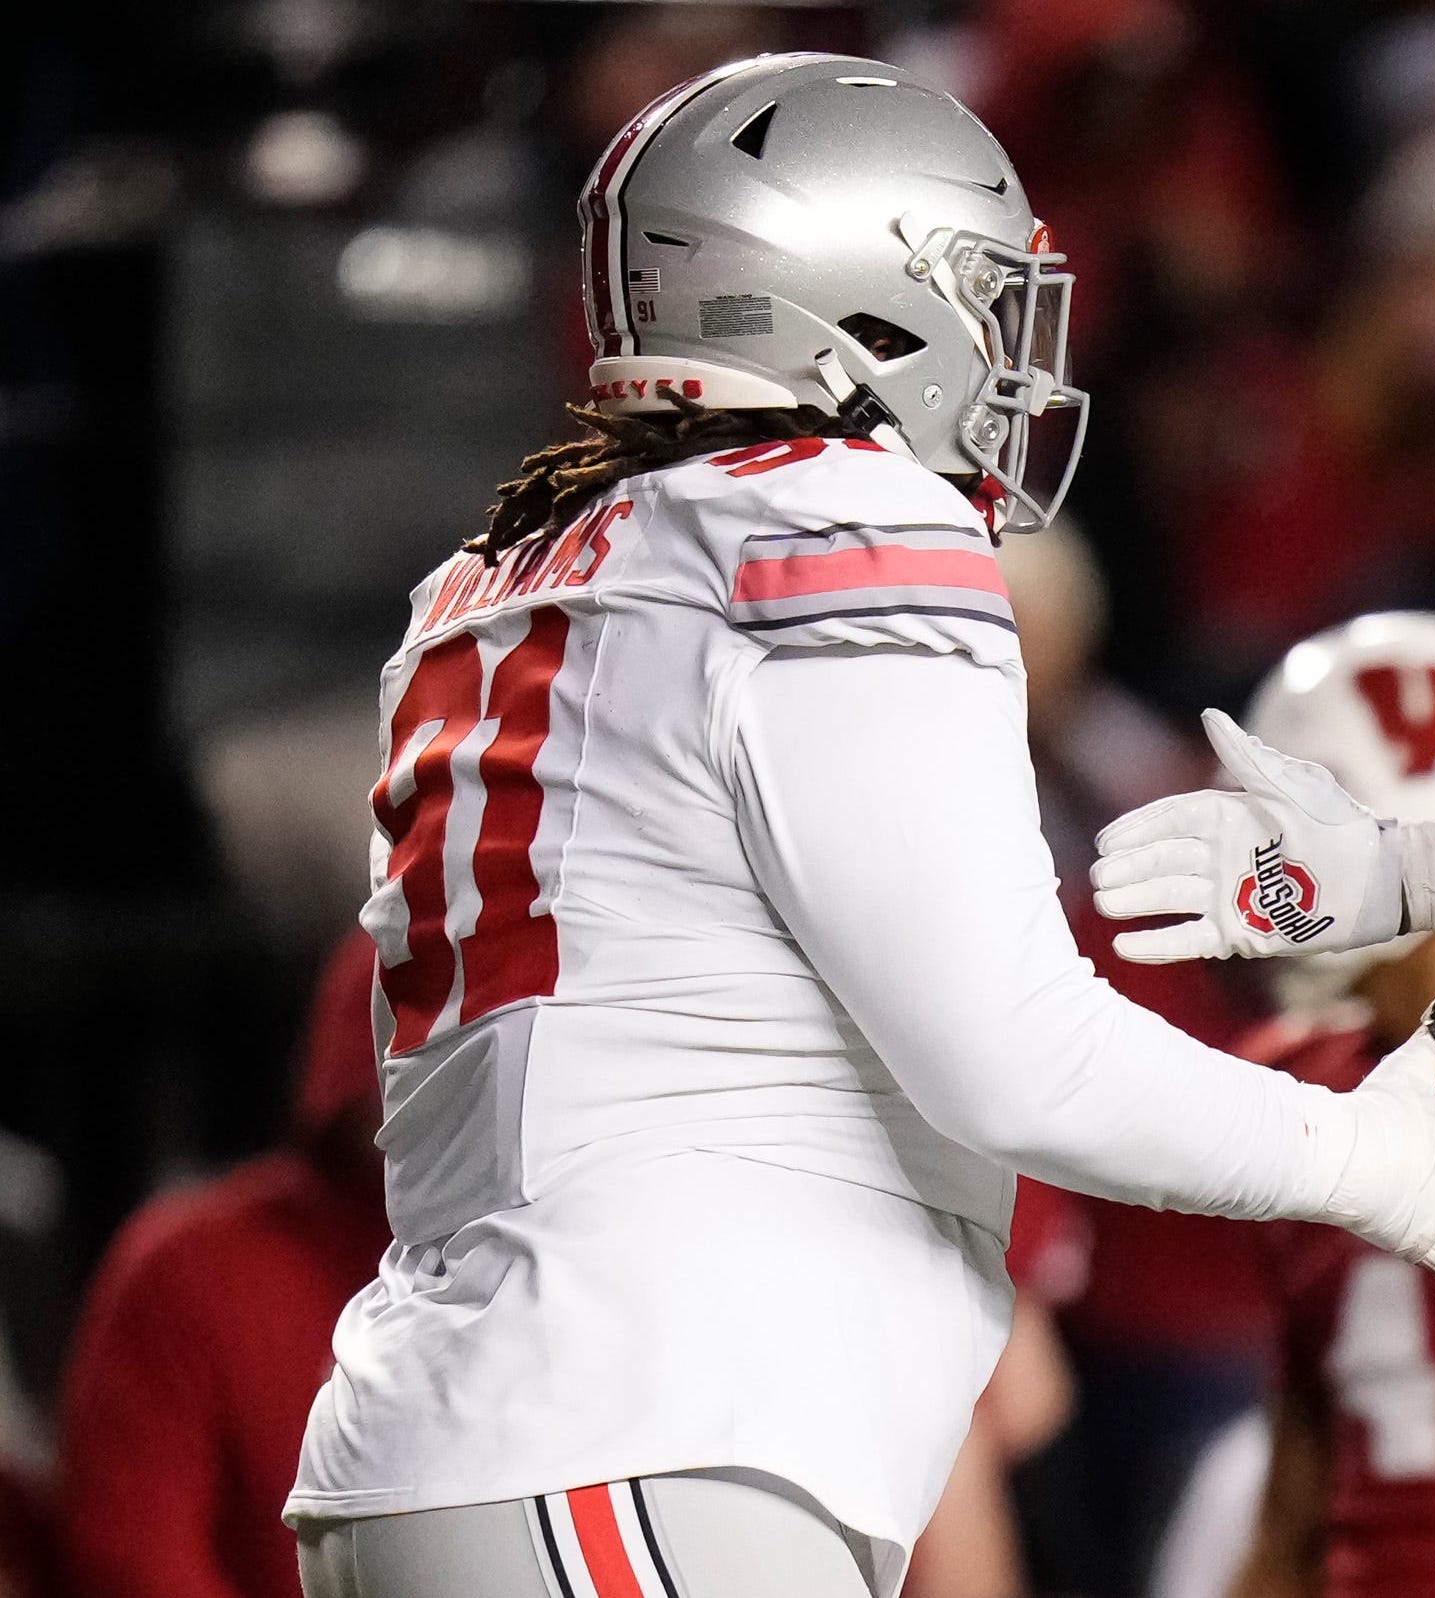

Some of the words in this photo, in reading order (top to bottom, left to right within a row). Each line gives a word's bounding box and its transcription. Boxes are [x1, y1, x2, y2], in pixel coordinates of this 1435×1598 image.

[637, 300, 657, 323] 91
[372, 603, 570, 1057] 91
[1255, 833, 1294, 909] STATE
[1269, 901, 1335, 943] OHIO
